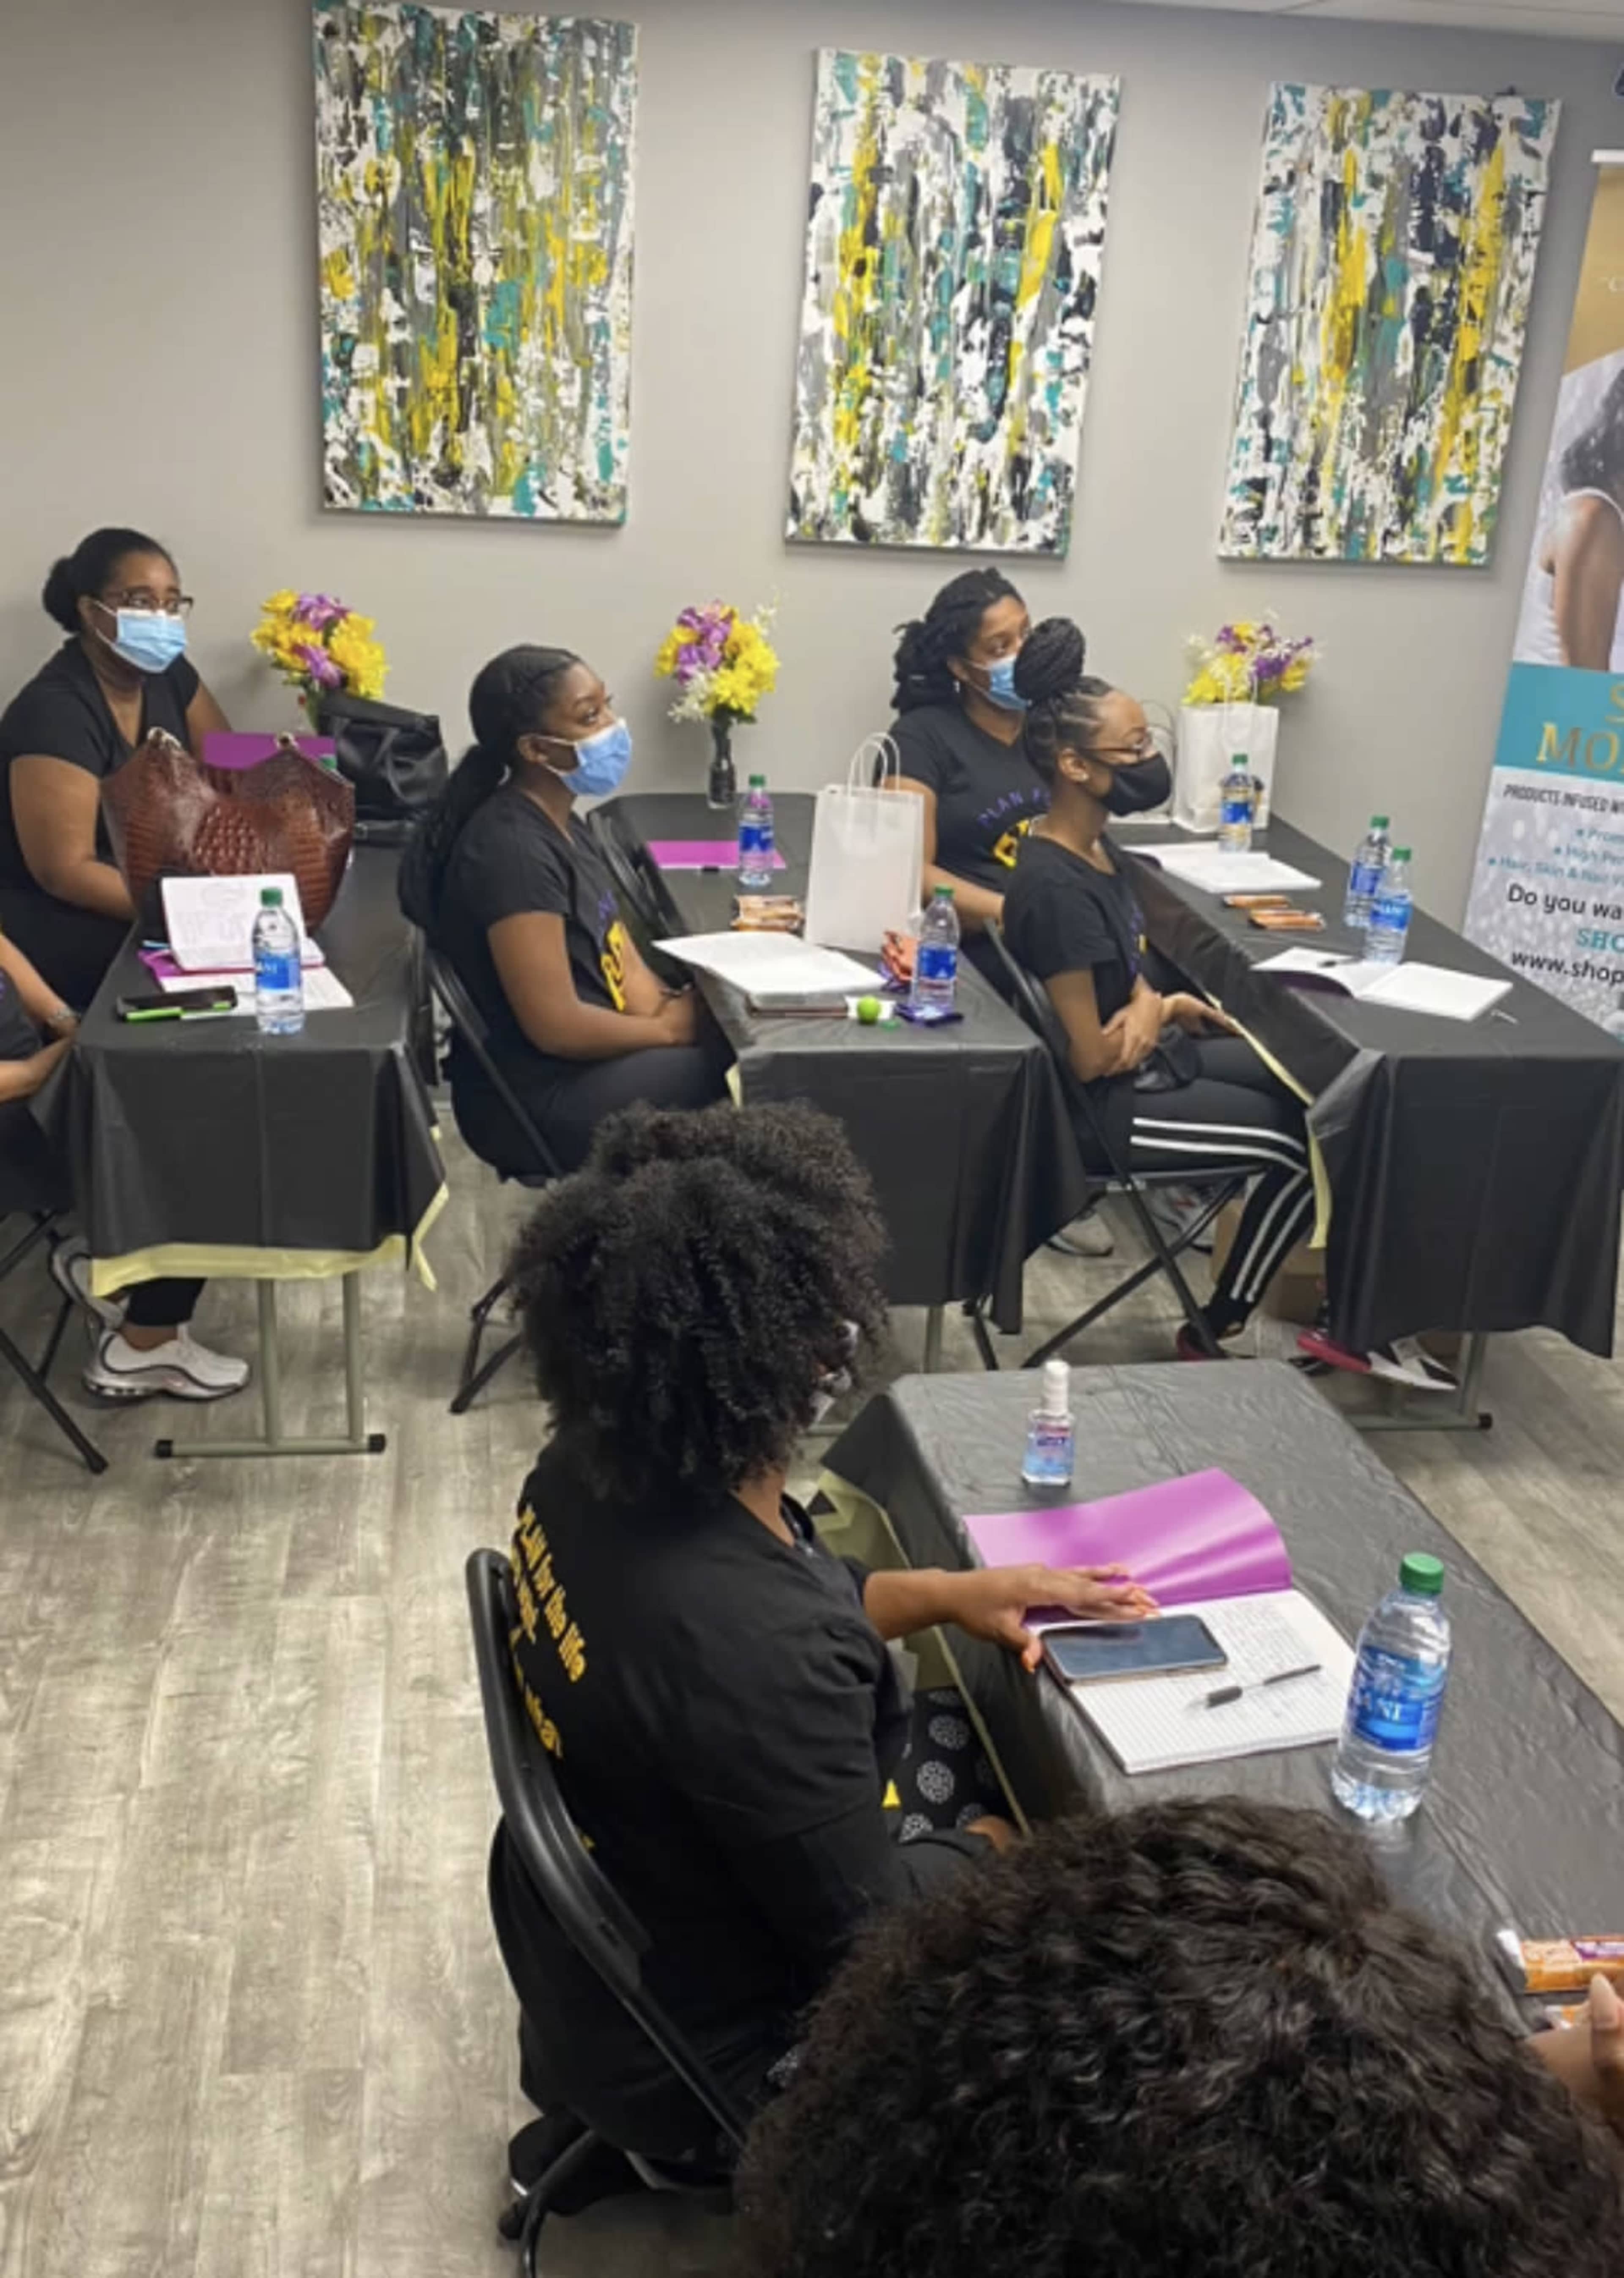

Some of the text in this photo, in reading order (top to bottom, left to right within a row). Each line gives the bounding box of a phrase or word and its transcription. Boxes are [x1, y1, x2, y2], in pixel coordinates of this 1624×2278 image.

[1536, 721, 1624, 777] MO
[1507, 882, 1623, 920] Do you wa
